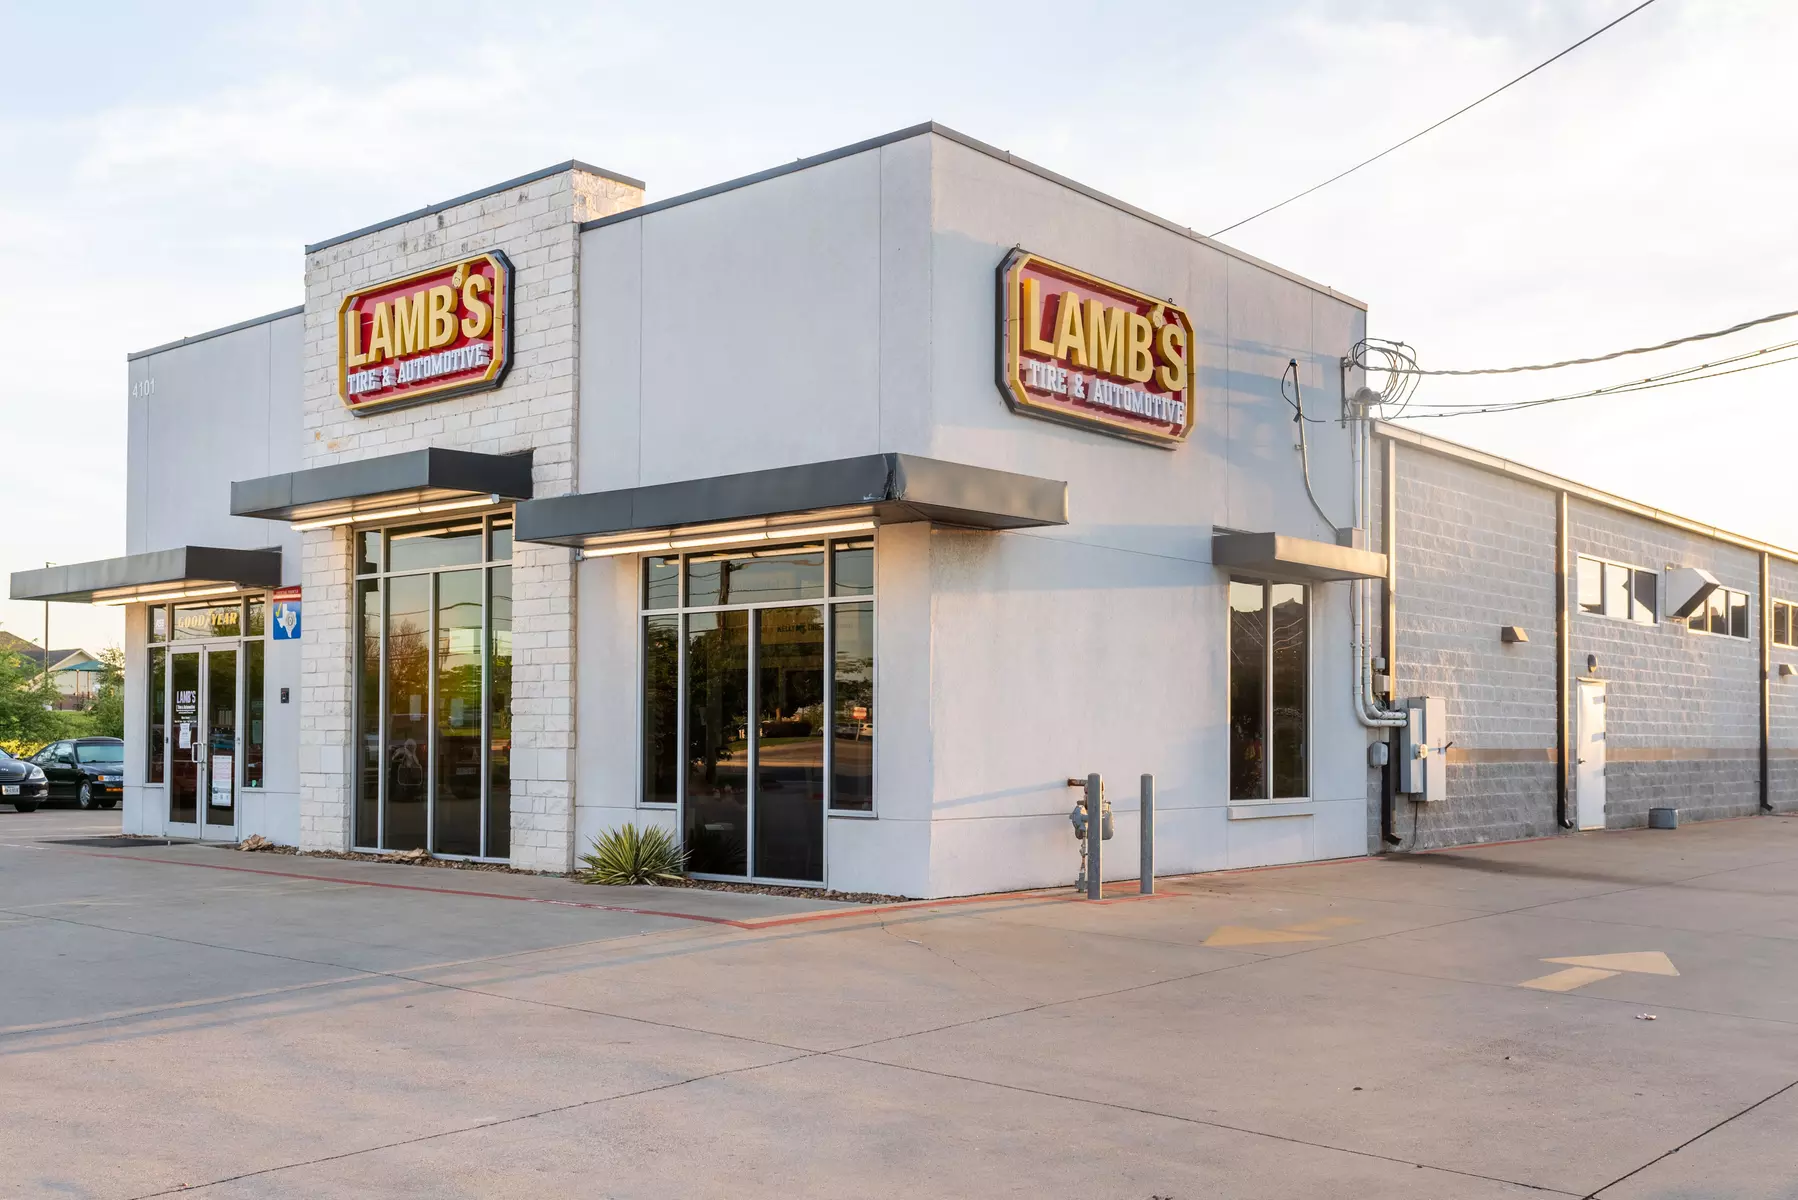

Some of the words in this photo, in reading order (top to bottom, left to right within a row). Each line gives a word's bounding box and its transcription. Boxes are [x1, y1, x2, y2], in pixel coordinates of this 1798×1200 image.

[348, 263, 492, 367] LAMB'S
[1024, 277, 1186, 392] LAMB'S
[132, 377, 155, 398] 4101
[348, 370, 382, 395] TIRE
[382, 366, 397, 387] &
[397, 342, 490, 384] AUTOMOTIVE
[1027, 360, 1068, 394] TIRE
[1069, 374, 1086, 399] &
[1089, 379, 1186, 425] AUTOMOTIVE
